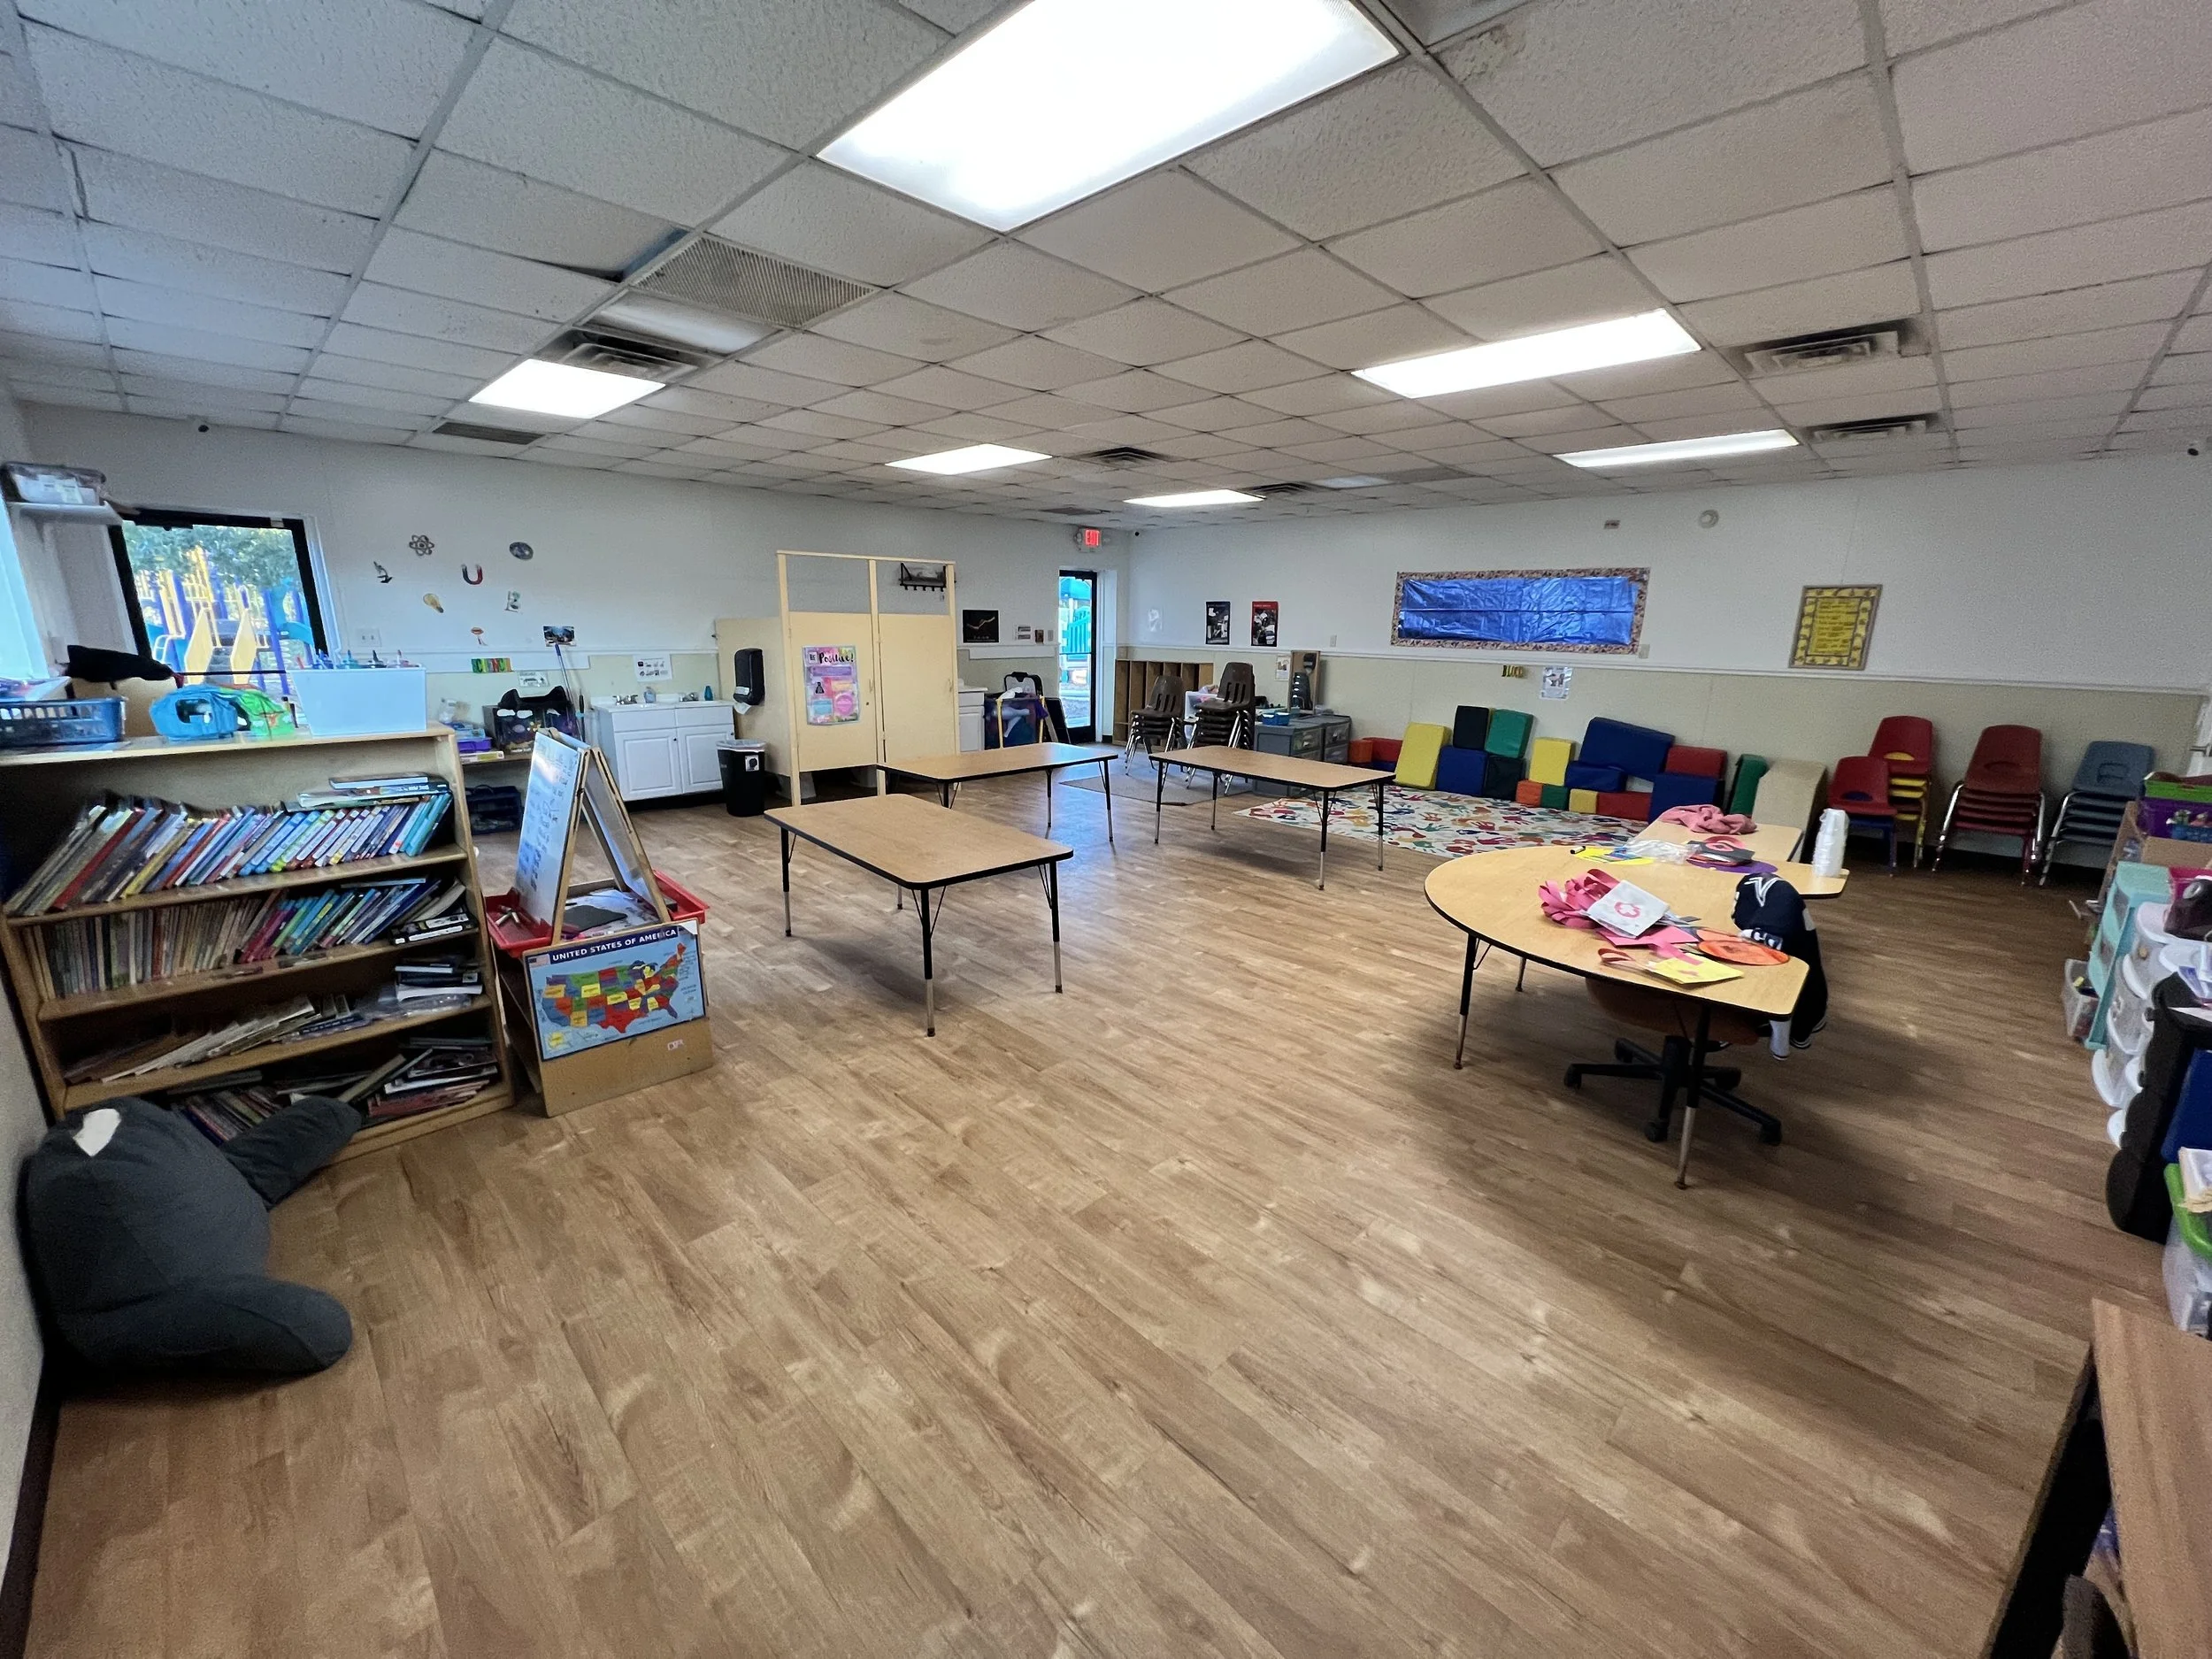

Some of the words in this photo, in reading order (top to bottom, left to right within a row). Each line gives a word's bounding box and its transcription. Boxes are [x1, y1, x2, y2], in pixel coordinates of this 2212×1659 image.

[1085, 529, 1100, 547] EXIT
[818, 651, 854, 664] Positive!
[552, 949, 588, 962] UNITED
[589, 941, 623, 954] STATES
[624, 937, 637, 947] OF
[639, 929, 677, 944] AMERICA
